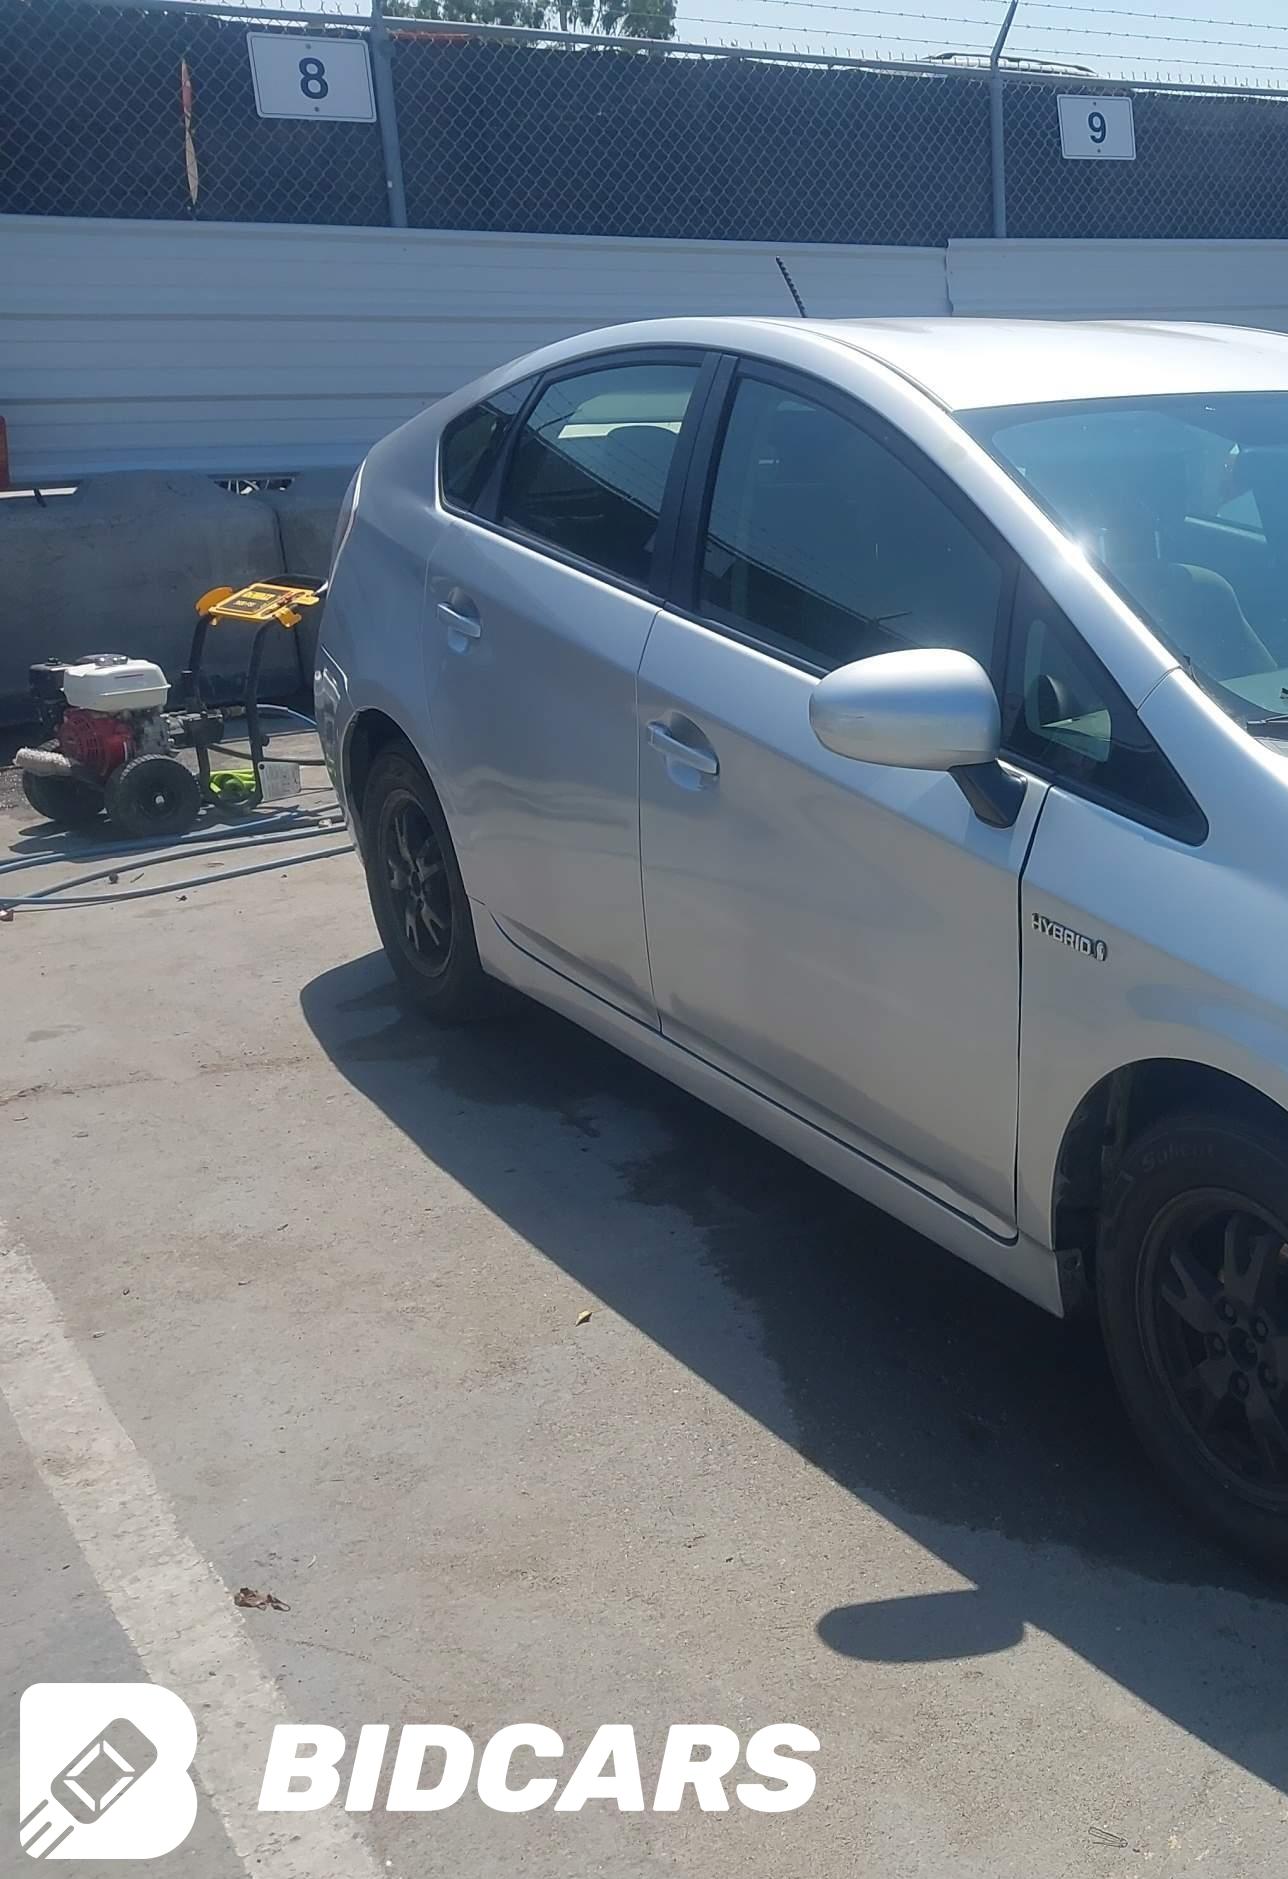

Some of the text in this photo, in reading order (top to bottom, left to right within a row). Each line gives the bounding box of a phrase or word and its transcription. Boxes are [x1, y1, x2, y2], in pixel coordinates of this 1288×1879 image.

[298, 57, 329, 99] 8
[1087, 111, 1107, 144] 9
[1031, 912, 1092, 955] HYBRID
